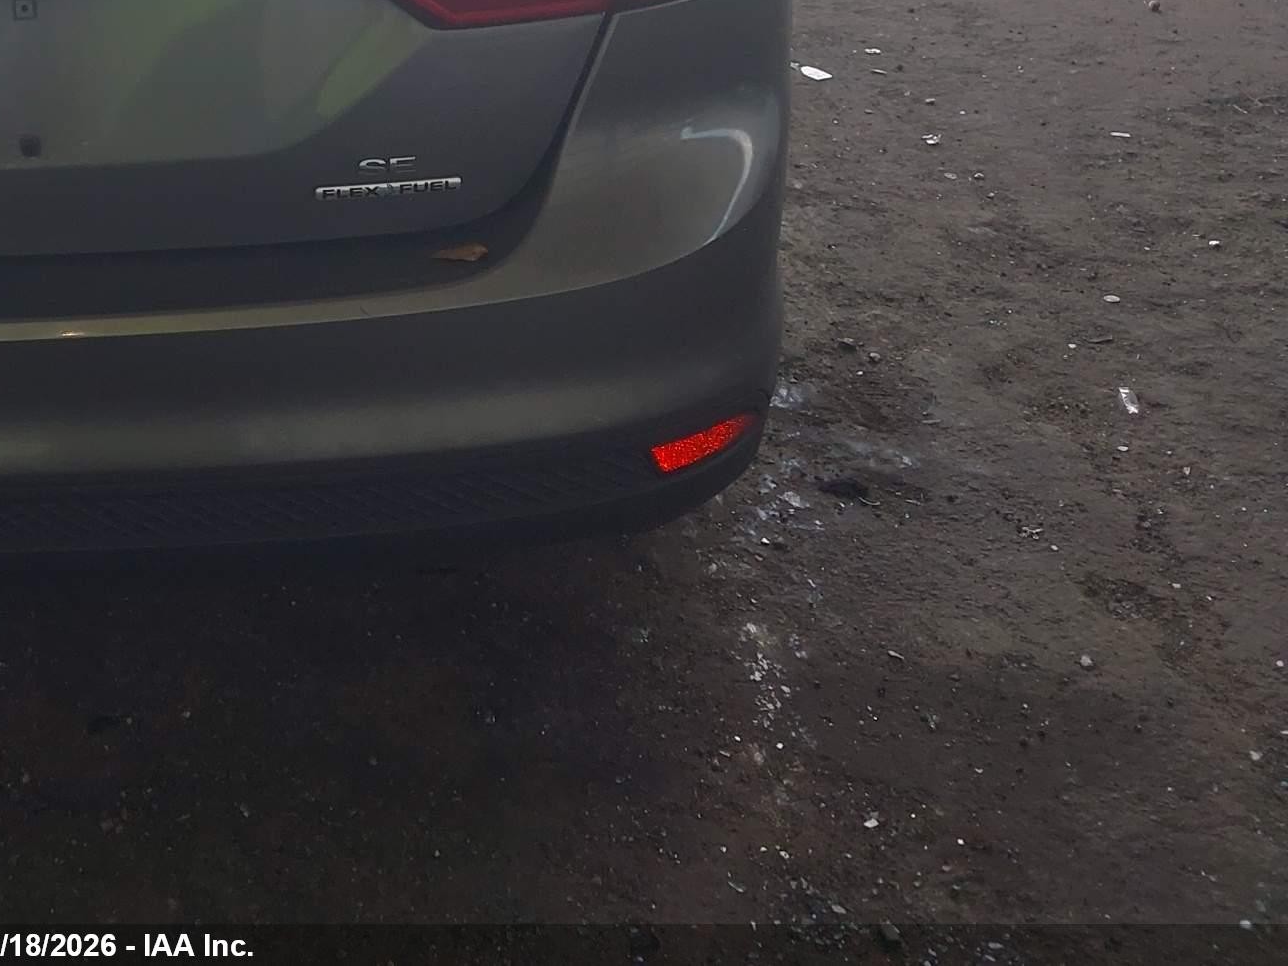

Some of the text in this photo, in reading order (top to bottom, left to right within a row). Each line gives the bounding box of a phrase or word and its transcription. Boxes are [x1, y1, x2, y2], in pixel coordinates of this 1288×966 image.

[358, 156, 416, 175] SE
[322, 179, 458, 199] FLEX FUEL
